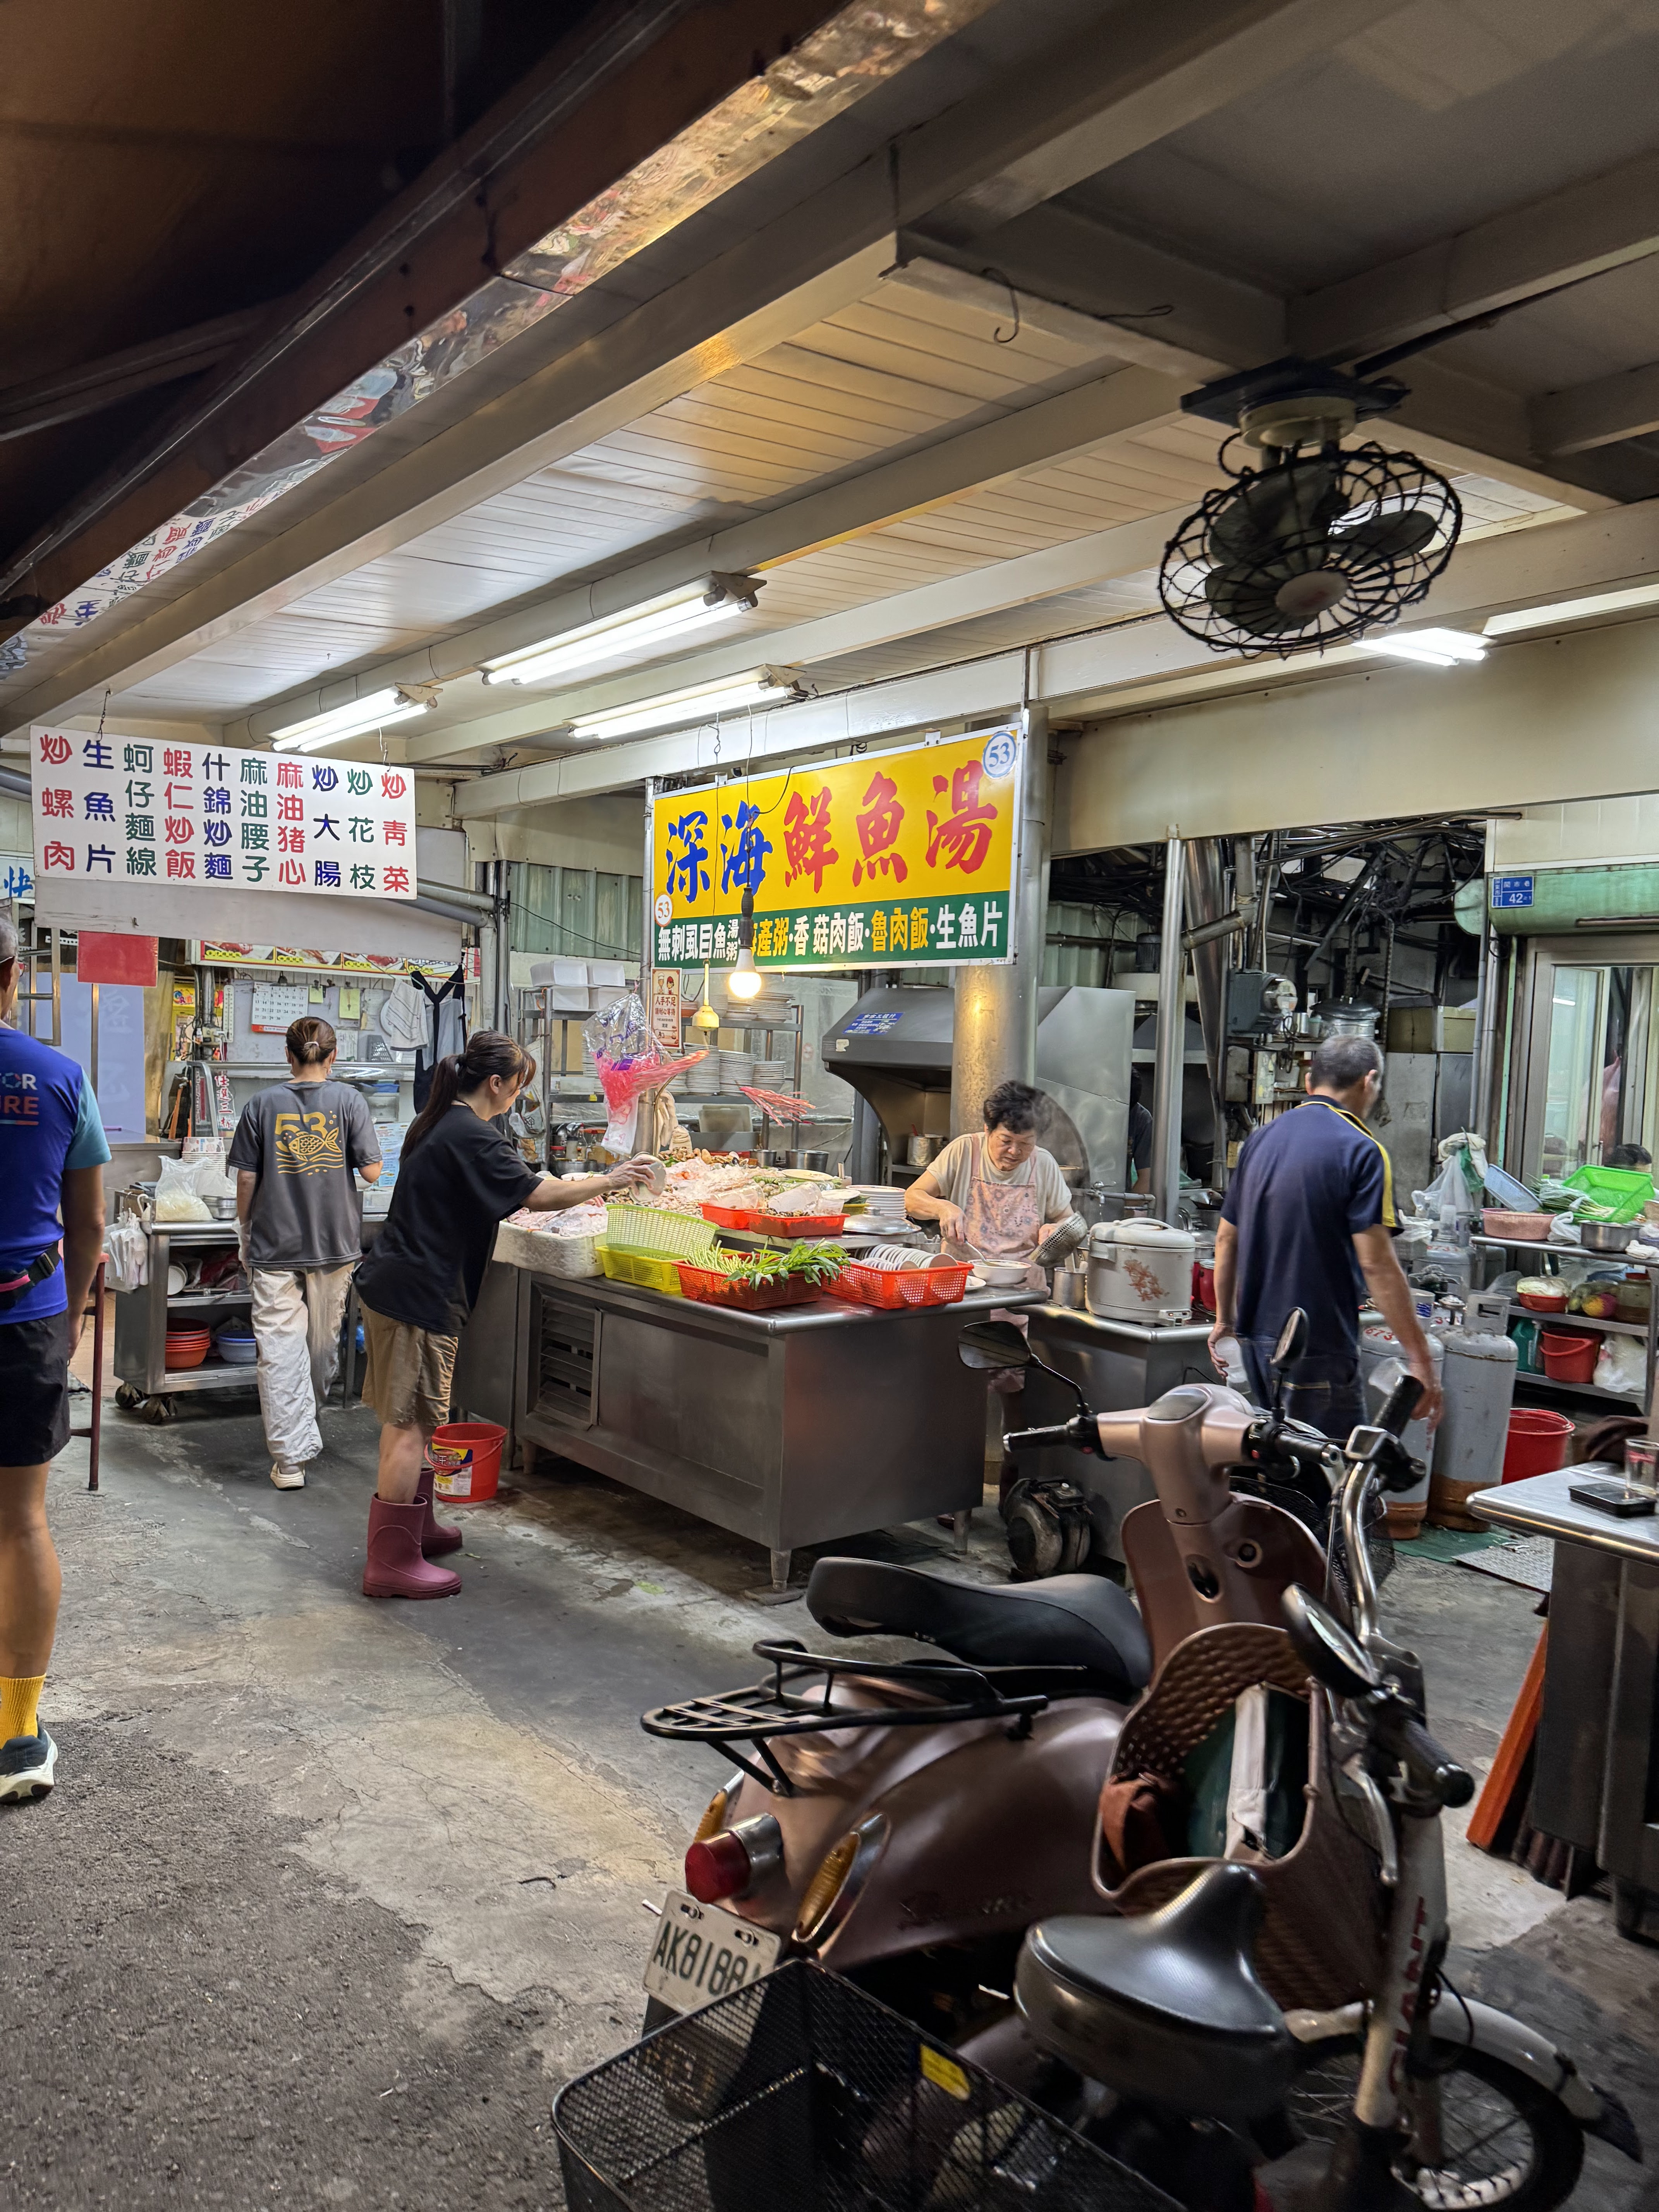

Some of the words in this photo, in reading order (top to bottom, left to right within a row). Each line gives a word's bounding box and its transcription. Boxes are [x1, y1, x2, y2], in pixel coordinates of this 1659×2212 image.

[40, 734, 74, 871] 炒螺肉
[83, 739, 115, 873] 生魚片
[124, 743, 157, 876] 蚵仔麵線
[163, 747, 196, 879] 蝦仁炒飯
[989, 742, 1010, 767] 53
[202, 752, 233, 879] 什錦炒麵
[240, 757, 270, 883] 麻油腰子
[312, 765, 341, 887] 炒大腸
[347, 769, 376, 890] 炒花枝
[381, 773, 409, 892] 炒青菜
[666, 759, 998, 903] 深海鮮魚湯
[658, 902, 670, 918] 53
[655, 996, 676, 1006] 人手不足
[0, 1072, 38, 1090] OR
[0, 1095, 39, 1115] RE
[275, 1111, 328, 1152] 53
